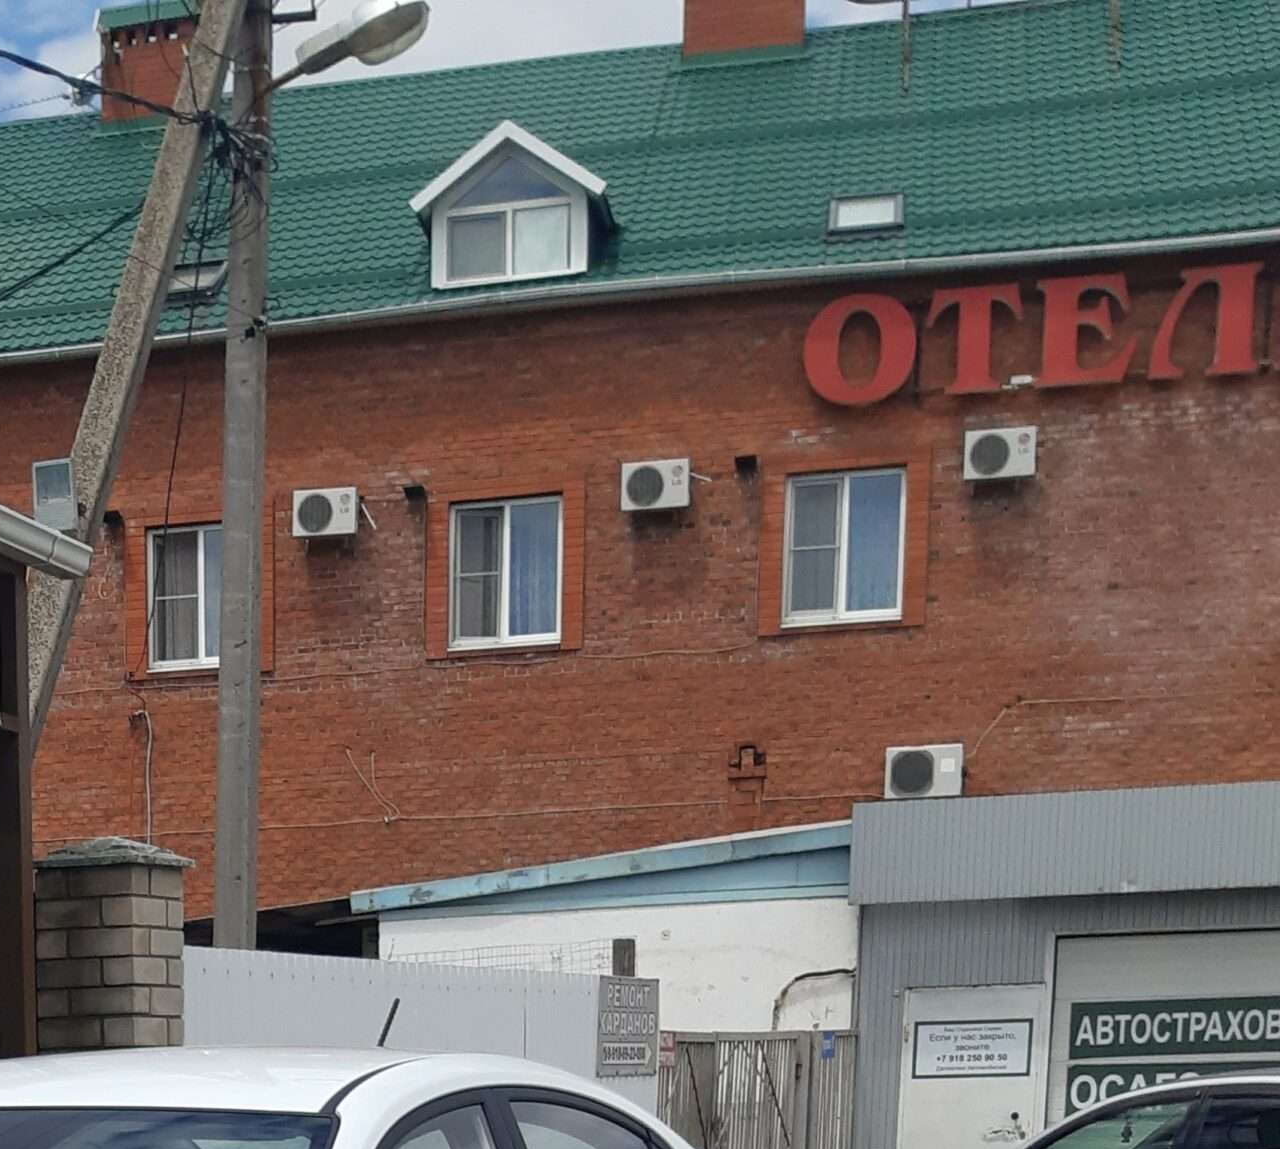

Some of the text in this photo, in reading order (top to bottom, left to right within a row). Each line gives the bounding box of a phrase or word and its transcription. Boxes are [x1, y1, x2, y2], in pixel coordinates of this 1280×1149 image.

[608, 984, 650, 1007] РЕМОНТ
[601, 1012, 656, 1036] КАРДАНОВ
[1074, 1008, 1280, 1047] АВТОСТРАХОВ
[929, 1033, 951, 1042] Если
[961, 1032, 977, 1040] нас
[937, 1054, 946, 1063] +7
[967, 1053, 982, 1062] 250
